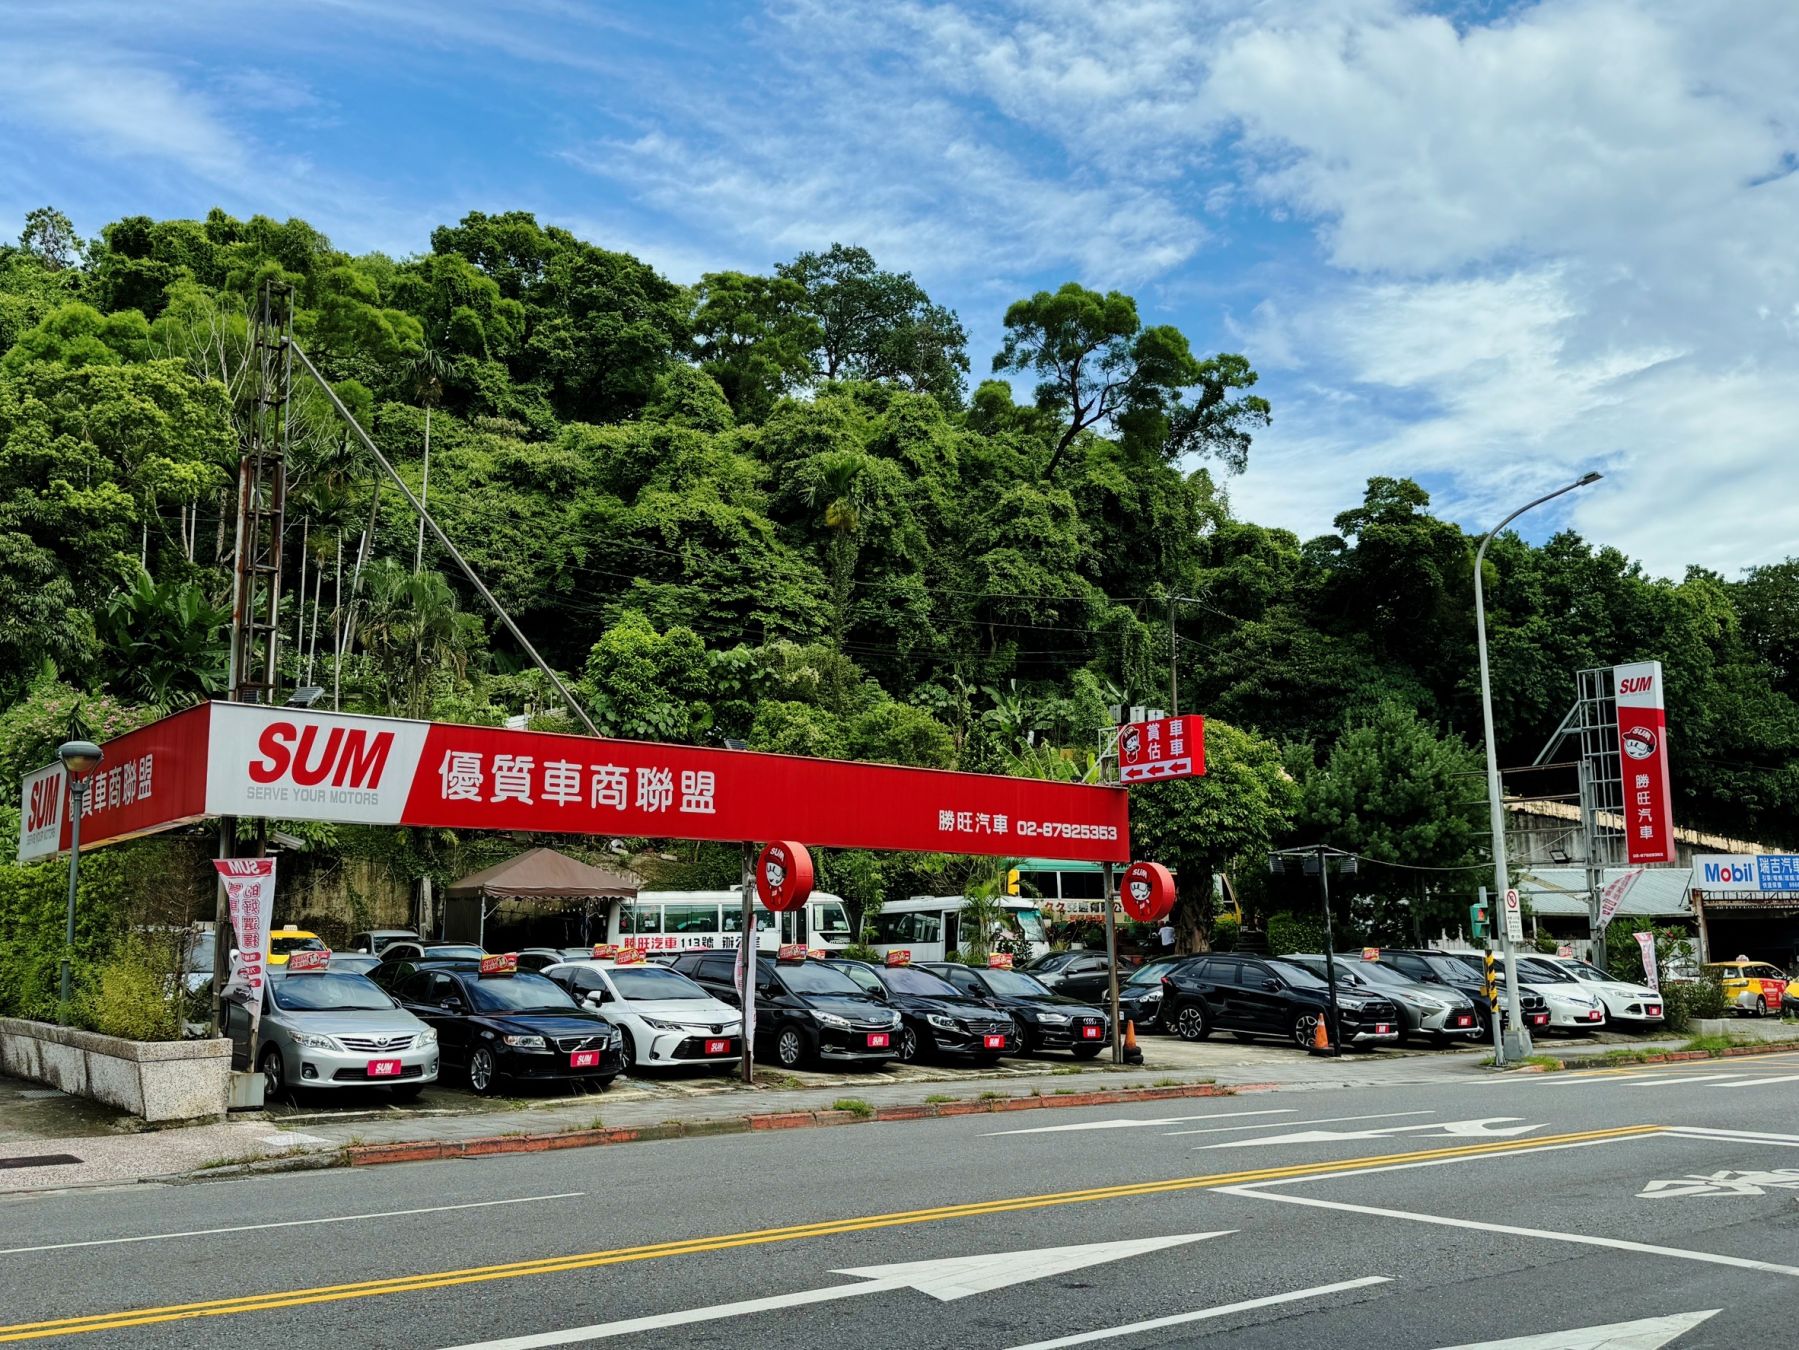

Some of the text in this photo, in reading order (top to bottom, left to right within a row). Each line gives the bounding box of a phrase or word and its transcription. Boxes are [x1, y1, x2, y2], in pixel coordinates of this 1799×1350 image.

[1620, 676, 1652, 694] SUM
[1632, 727, 1652, 741] SUM
[249, 722, 395, 789] SUM
[438, 749, 717, 814] 優質車商聯盟
[28, 773, 60, 833] SUM
[247, 786, 379, 805] SERVE YOUR MOTORS
[1635, 773, 1653, 839] 勝旺汽車
[938, 810, 1118, 841] 勝旺汽車 02-87925353
[770, 847, 785, 862] SUM
[1132, 868, 1148, 879] SUM
[1704, 863, 1753, 882] Mobil
[375, 1062, 394, 1073] SUM
